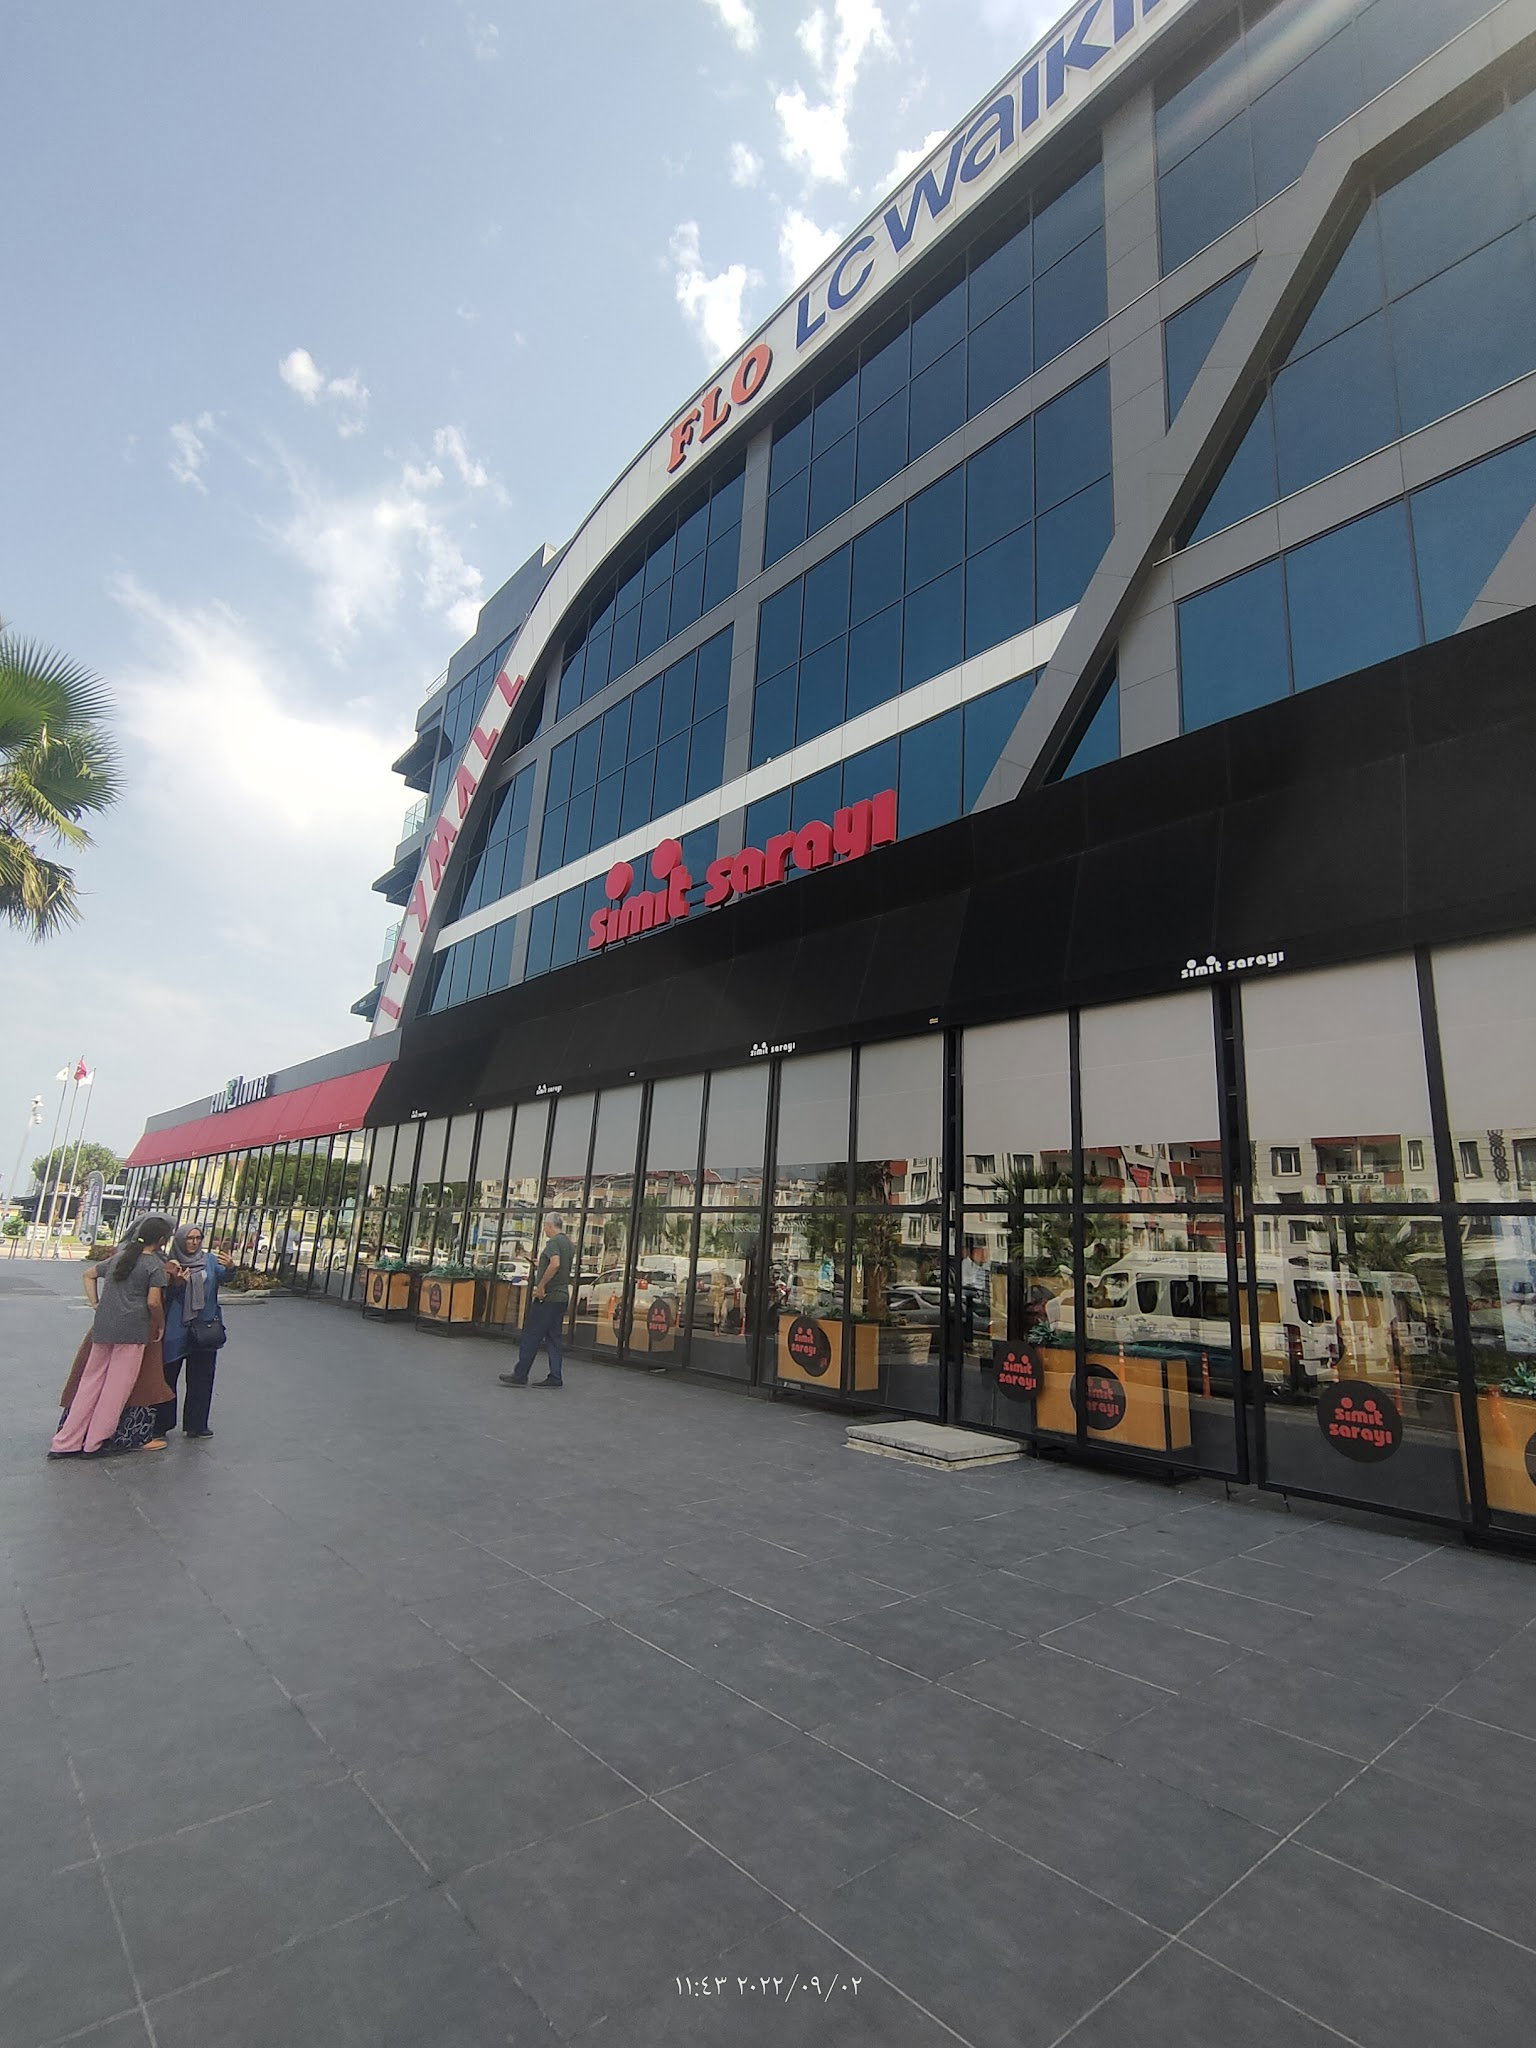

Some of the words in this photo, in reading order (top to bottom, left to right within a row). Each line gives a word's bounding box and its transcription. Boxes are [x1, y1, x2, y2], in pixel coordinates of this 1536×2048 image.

[796, 235, 876, 349] LC
[667, 344, 773, 474] FLO
[588, 838, 692, 951] simit
[704, 788, 898, 908] sarayı
[1181, 955, 1222, 979] simit
[1227, 951, 1285, 970] sarayı
[1003, 1352, 1033, 1375] simit
[999, 1371, 1037, 1390] sarayı
[1334, 1396, 1384, 1427] simit
[1328, 1423, 1393, 1448] sarayı
